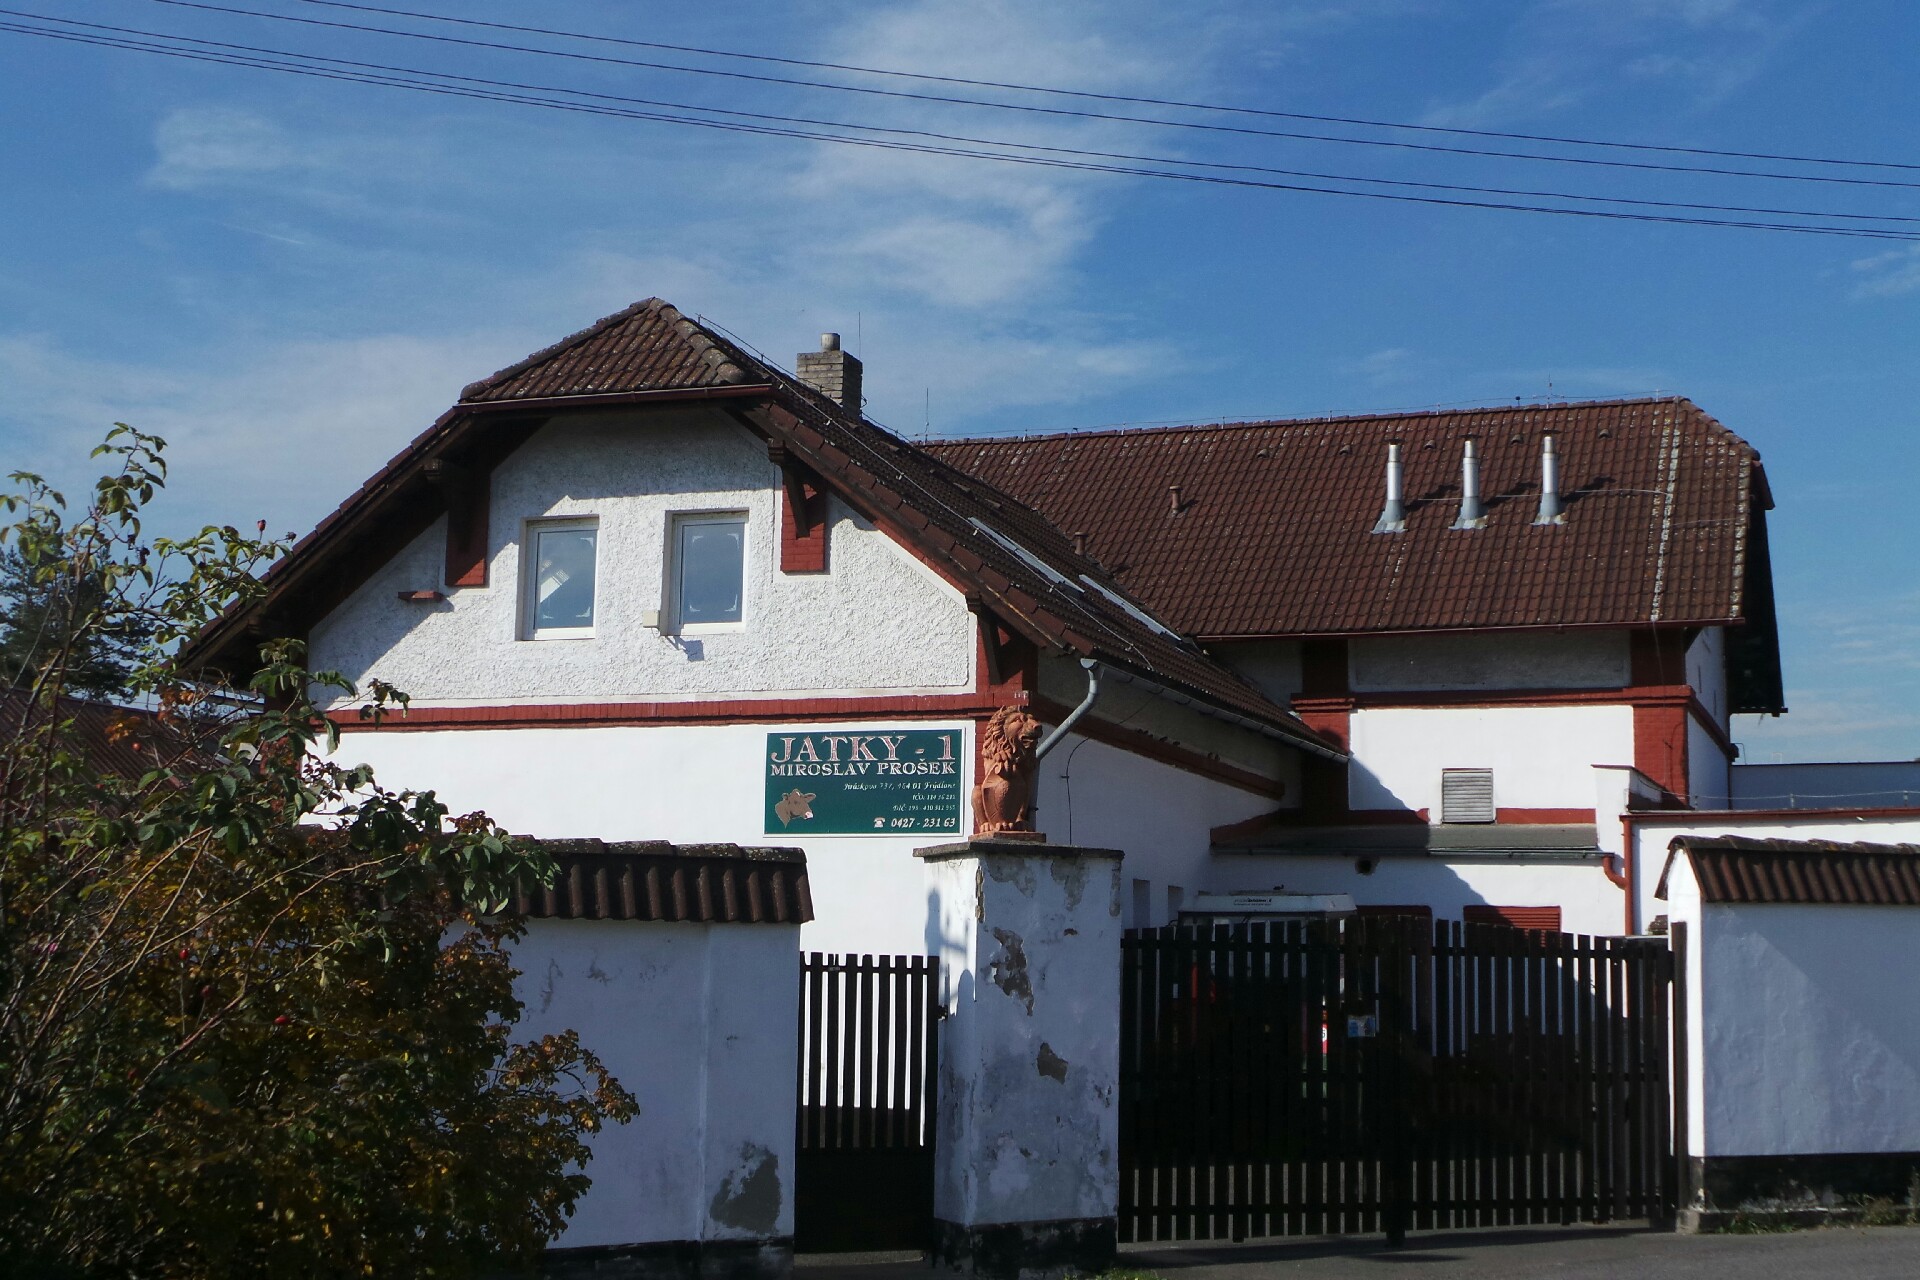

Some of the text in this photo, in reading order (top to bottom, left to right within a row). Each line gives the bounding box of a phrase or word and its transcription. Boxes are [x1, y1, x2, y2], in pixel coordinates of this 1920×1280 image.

[770, 735, 907, 763] JATKY
[937, 734, 956, 761] 1
[770, 759, 956, 776] MIROSLAV PROŠEK
[912, 782, 921, 790] 01
[891, 818, 915, 829] 0427
[922, 818, 941, 828] 231
[943, 818, 956, 828] 63
